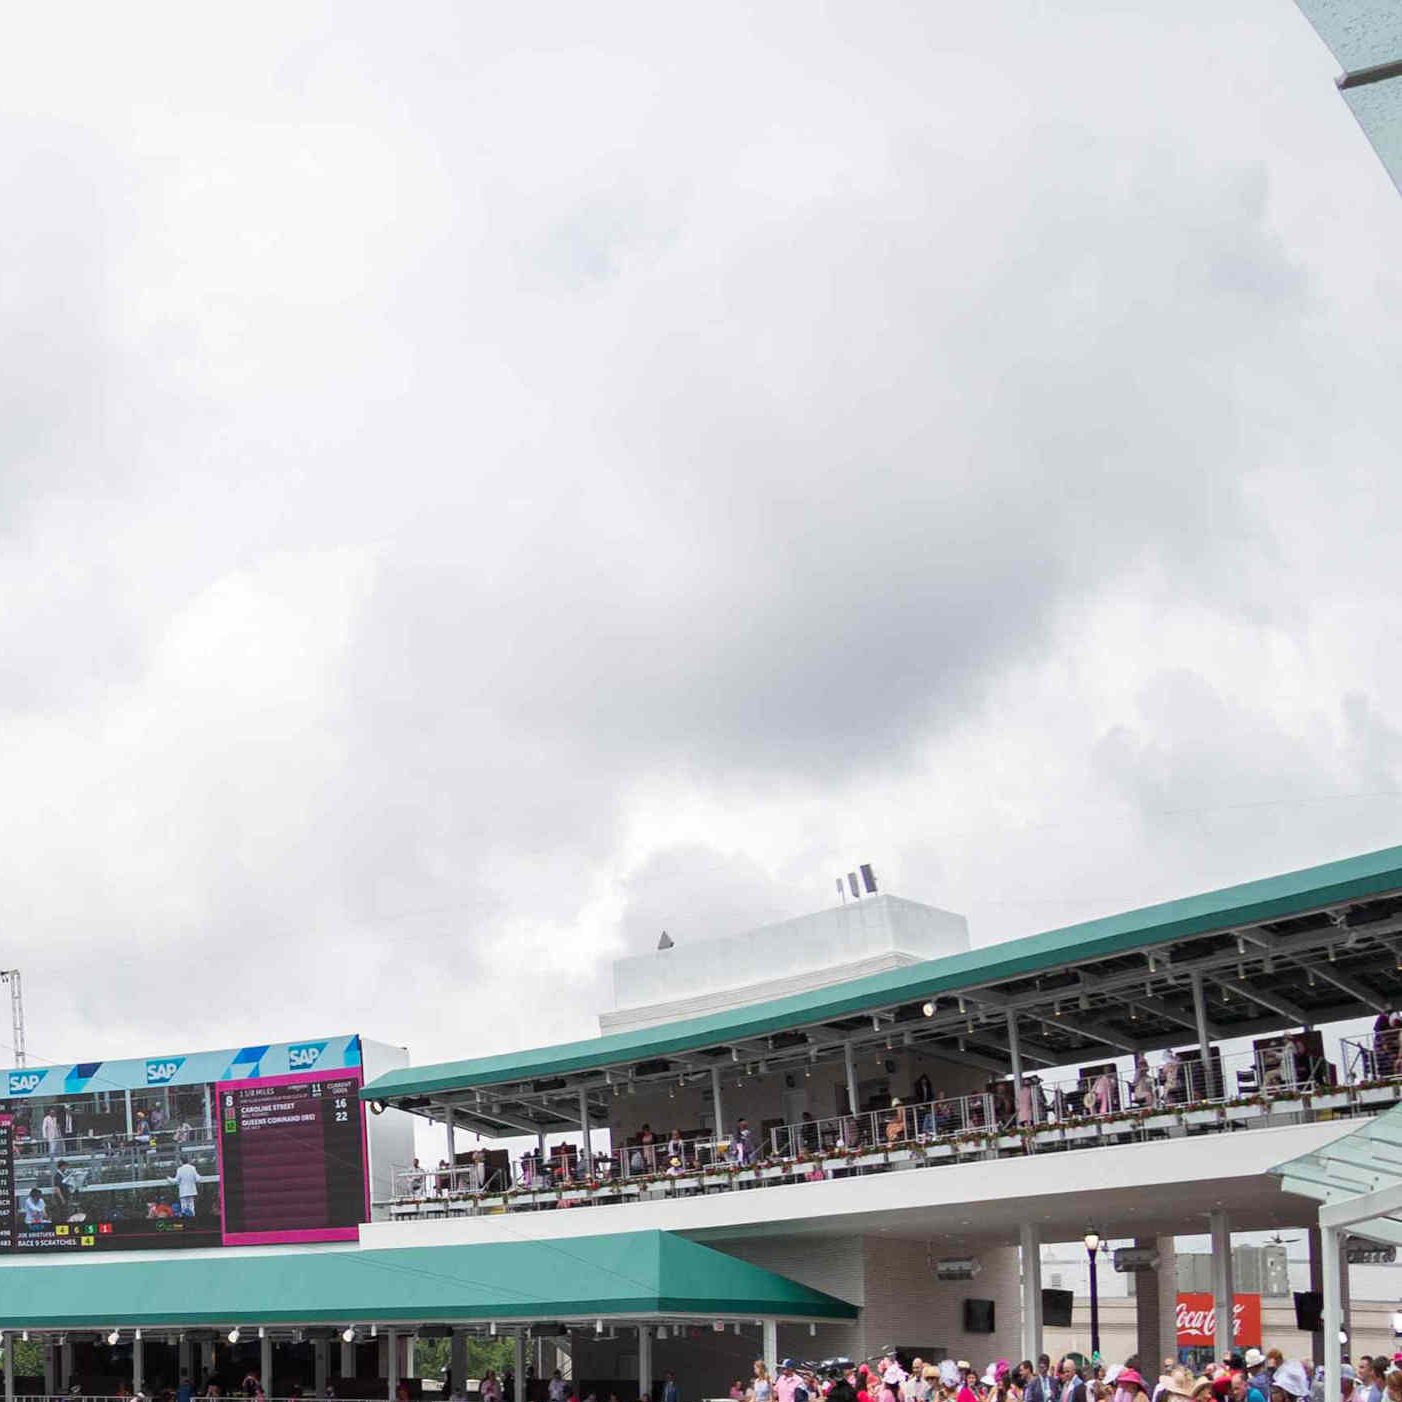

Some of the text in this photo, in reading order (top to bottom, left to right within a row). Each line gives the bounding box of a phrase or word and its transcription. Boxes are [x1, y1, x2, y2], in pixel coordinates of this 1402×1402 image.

[290, 1048, 319, 1066] SAP
[147, 1063, 177, 1081] SAP
[9, 1074, 40, 1092] SAP
[312, 1084, 321, 1093] 11
[226, 1096, 233, 1106] 8
[335, 1099, 347, 1108] 16
[267, 1116, 300, 1124] COMMAND
[336, 1112, 348, 1121] 22
